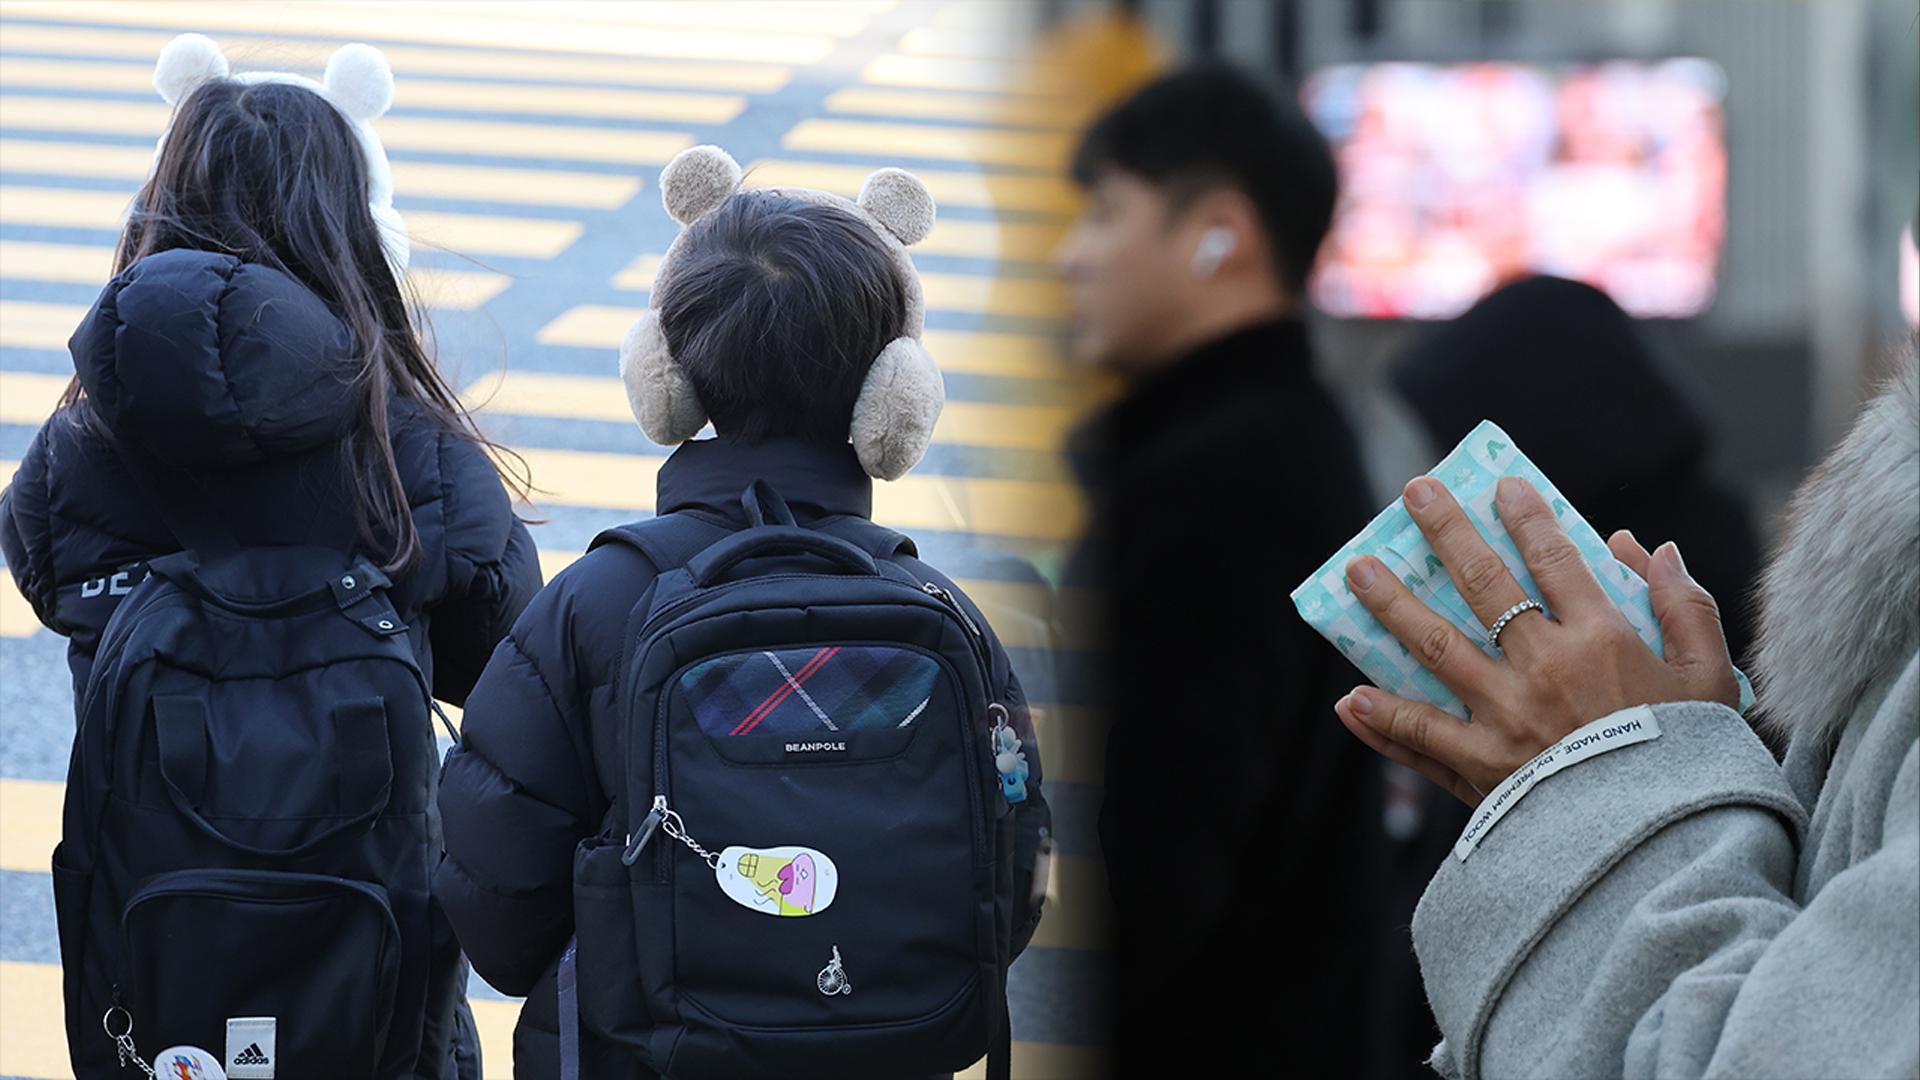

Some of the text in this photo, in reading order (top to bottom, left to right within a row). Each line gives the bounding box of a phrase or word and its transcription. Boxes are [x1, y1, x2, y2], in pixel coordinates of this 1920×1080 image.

[1602, 719, 1642, 739] HAND
[785, 742, 846, 752] BEANPOLE
[1565, 734, 1601, 755] MADE
[1492, 769, 1535, 811] PREMIUM
[1464, 811, 1493, 843] WOOL
[233, 1056, 270, 1065] adidas
